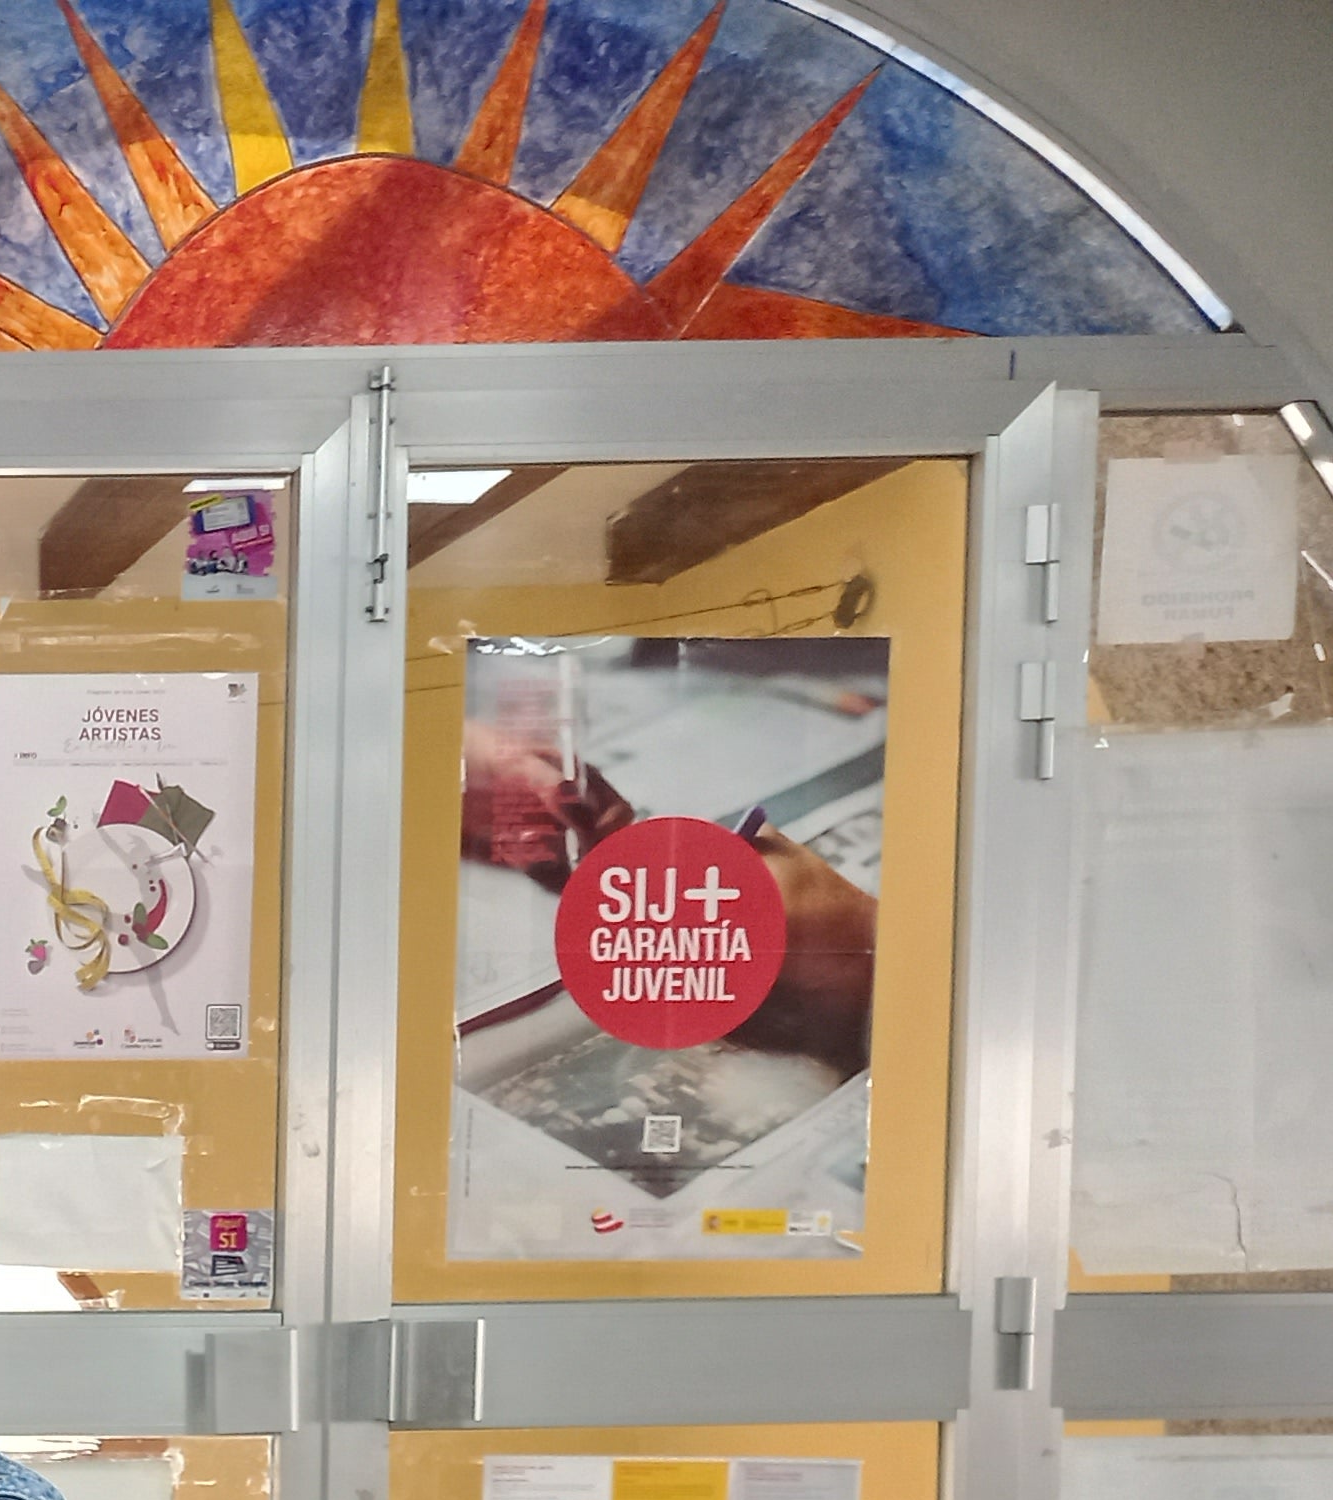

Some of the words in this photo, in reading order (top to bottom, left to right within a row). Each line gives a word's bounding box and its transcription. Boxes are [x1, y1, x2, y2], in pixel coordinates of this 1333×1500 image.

[82, 706, 159, 722] JÓVENES
[79, 727, 161, 741] ARTISTAS
[590, 919, 752, 963] GARANTÍA
[603, 966, 735, 1003] JUVENIL
